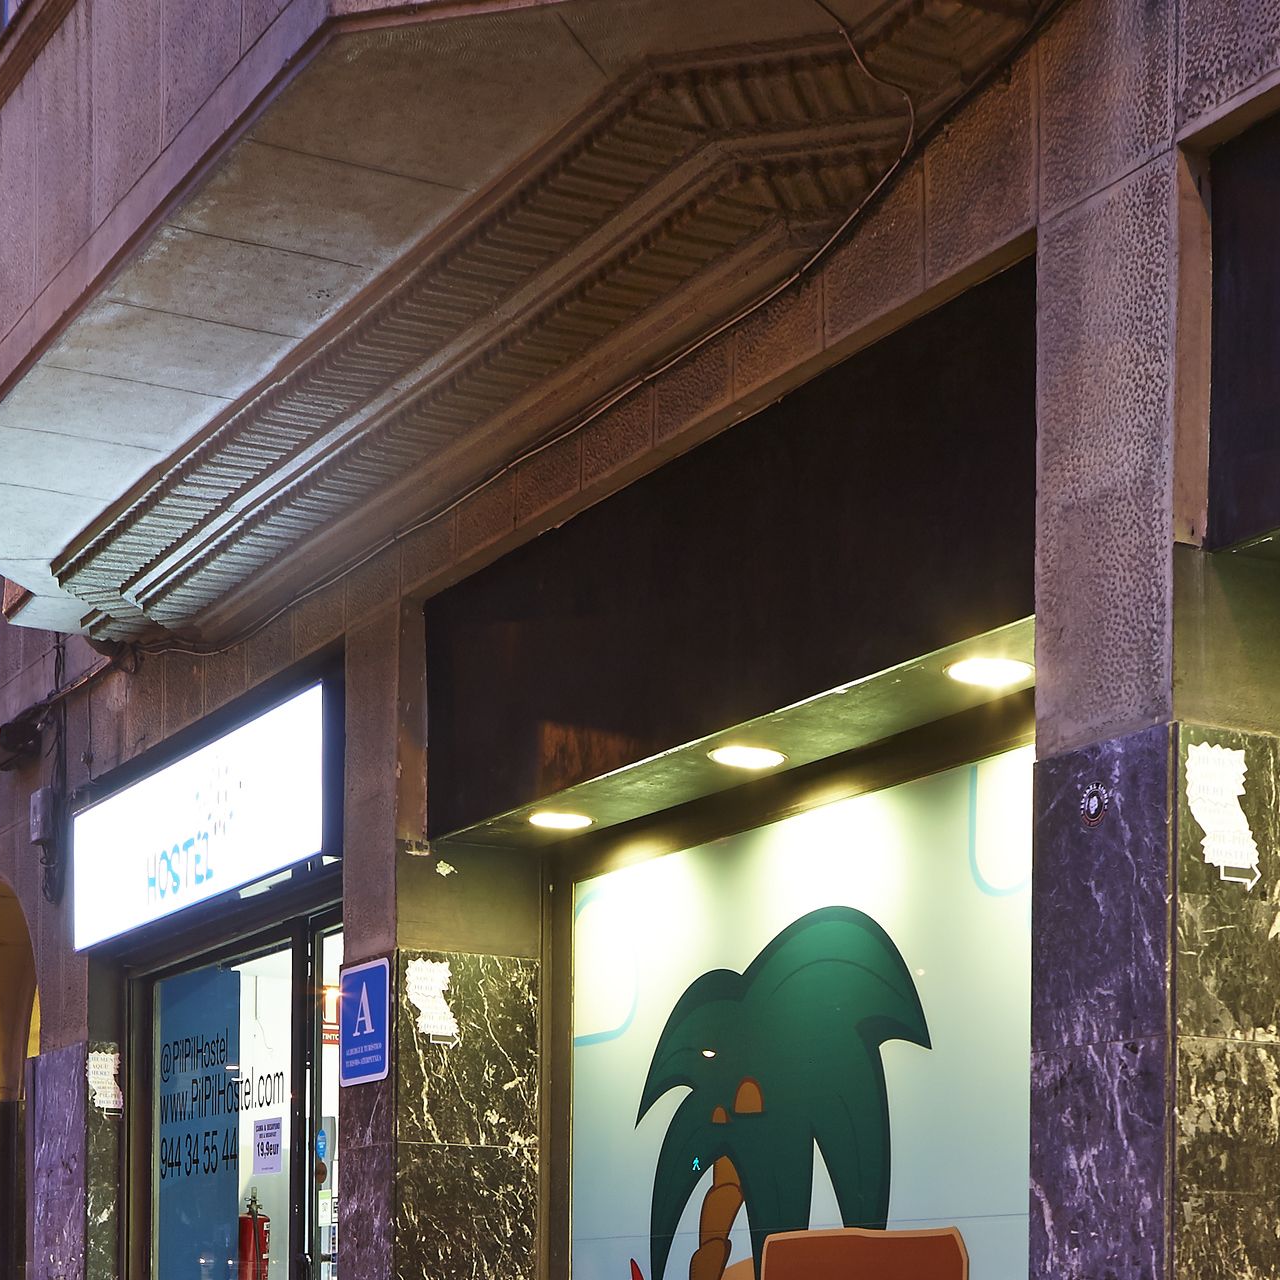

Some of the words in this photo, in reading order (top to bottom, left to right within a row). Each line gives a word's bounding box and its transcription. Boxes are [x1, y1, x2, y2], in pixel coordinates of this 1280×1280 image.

[147, 831, 213, 904] HOSTEL
[353, 981, 374, 1037] A
[161, 1027, 228, 1083] @PilPilHostel
[160, 1066, 284, 1125] www.PilPilHostel.com
[160, 1134, 181, 1180] 944
[185, 1131, 199, 1176] 34
[203, 1130, 218, 1174] 55
[222, 1127, 237, 1171] 44
